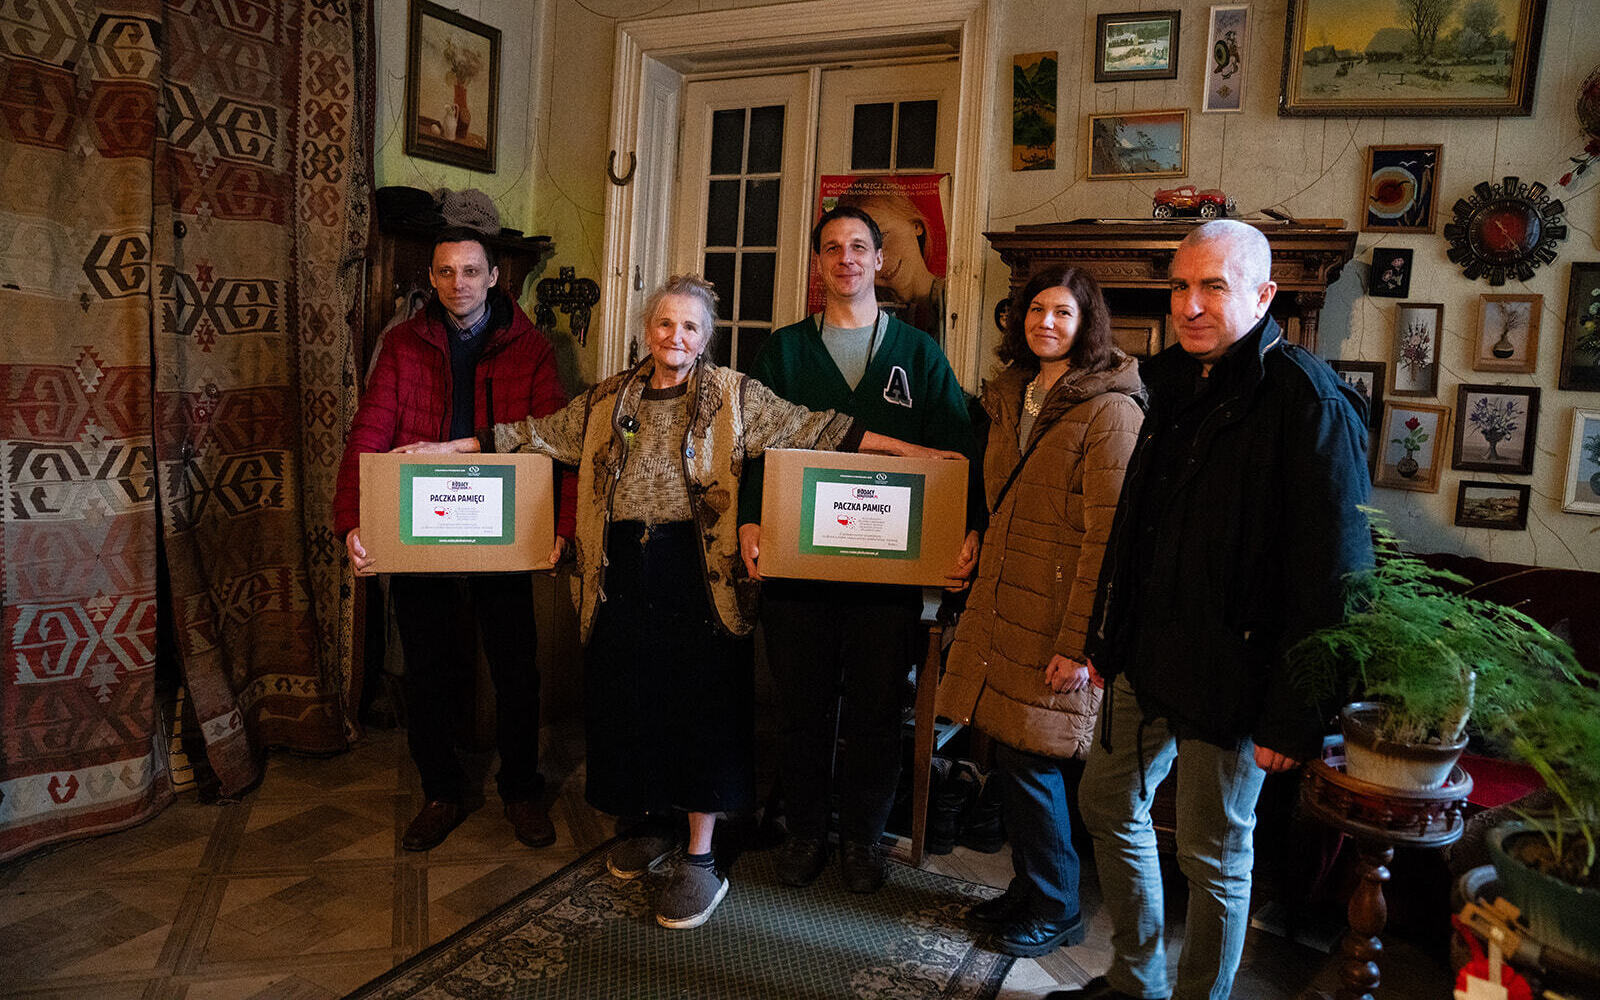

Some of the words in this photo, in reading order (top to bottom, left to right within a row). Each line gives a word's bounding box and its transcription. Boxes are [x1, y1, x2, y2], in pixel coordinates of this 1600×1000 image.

[883, 365, 913, 408] A
[430, 494, 456, 503] PACZKA
[457, 494, 485, 504] PAMIĘCI
[833, 501, 861, 511] PACZKA
[862, 504, 891, 515] PAMIĘCI
